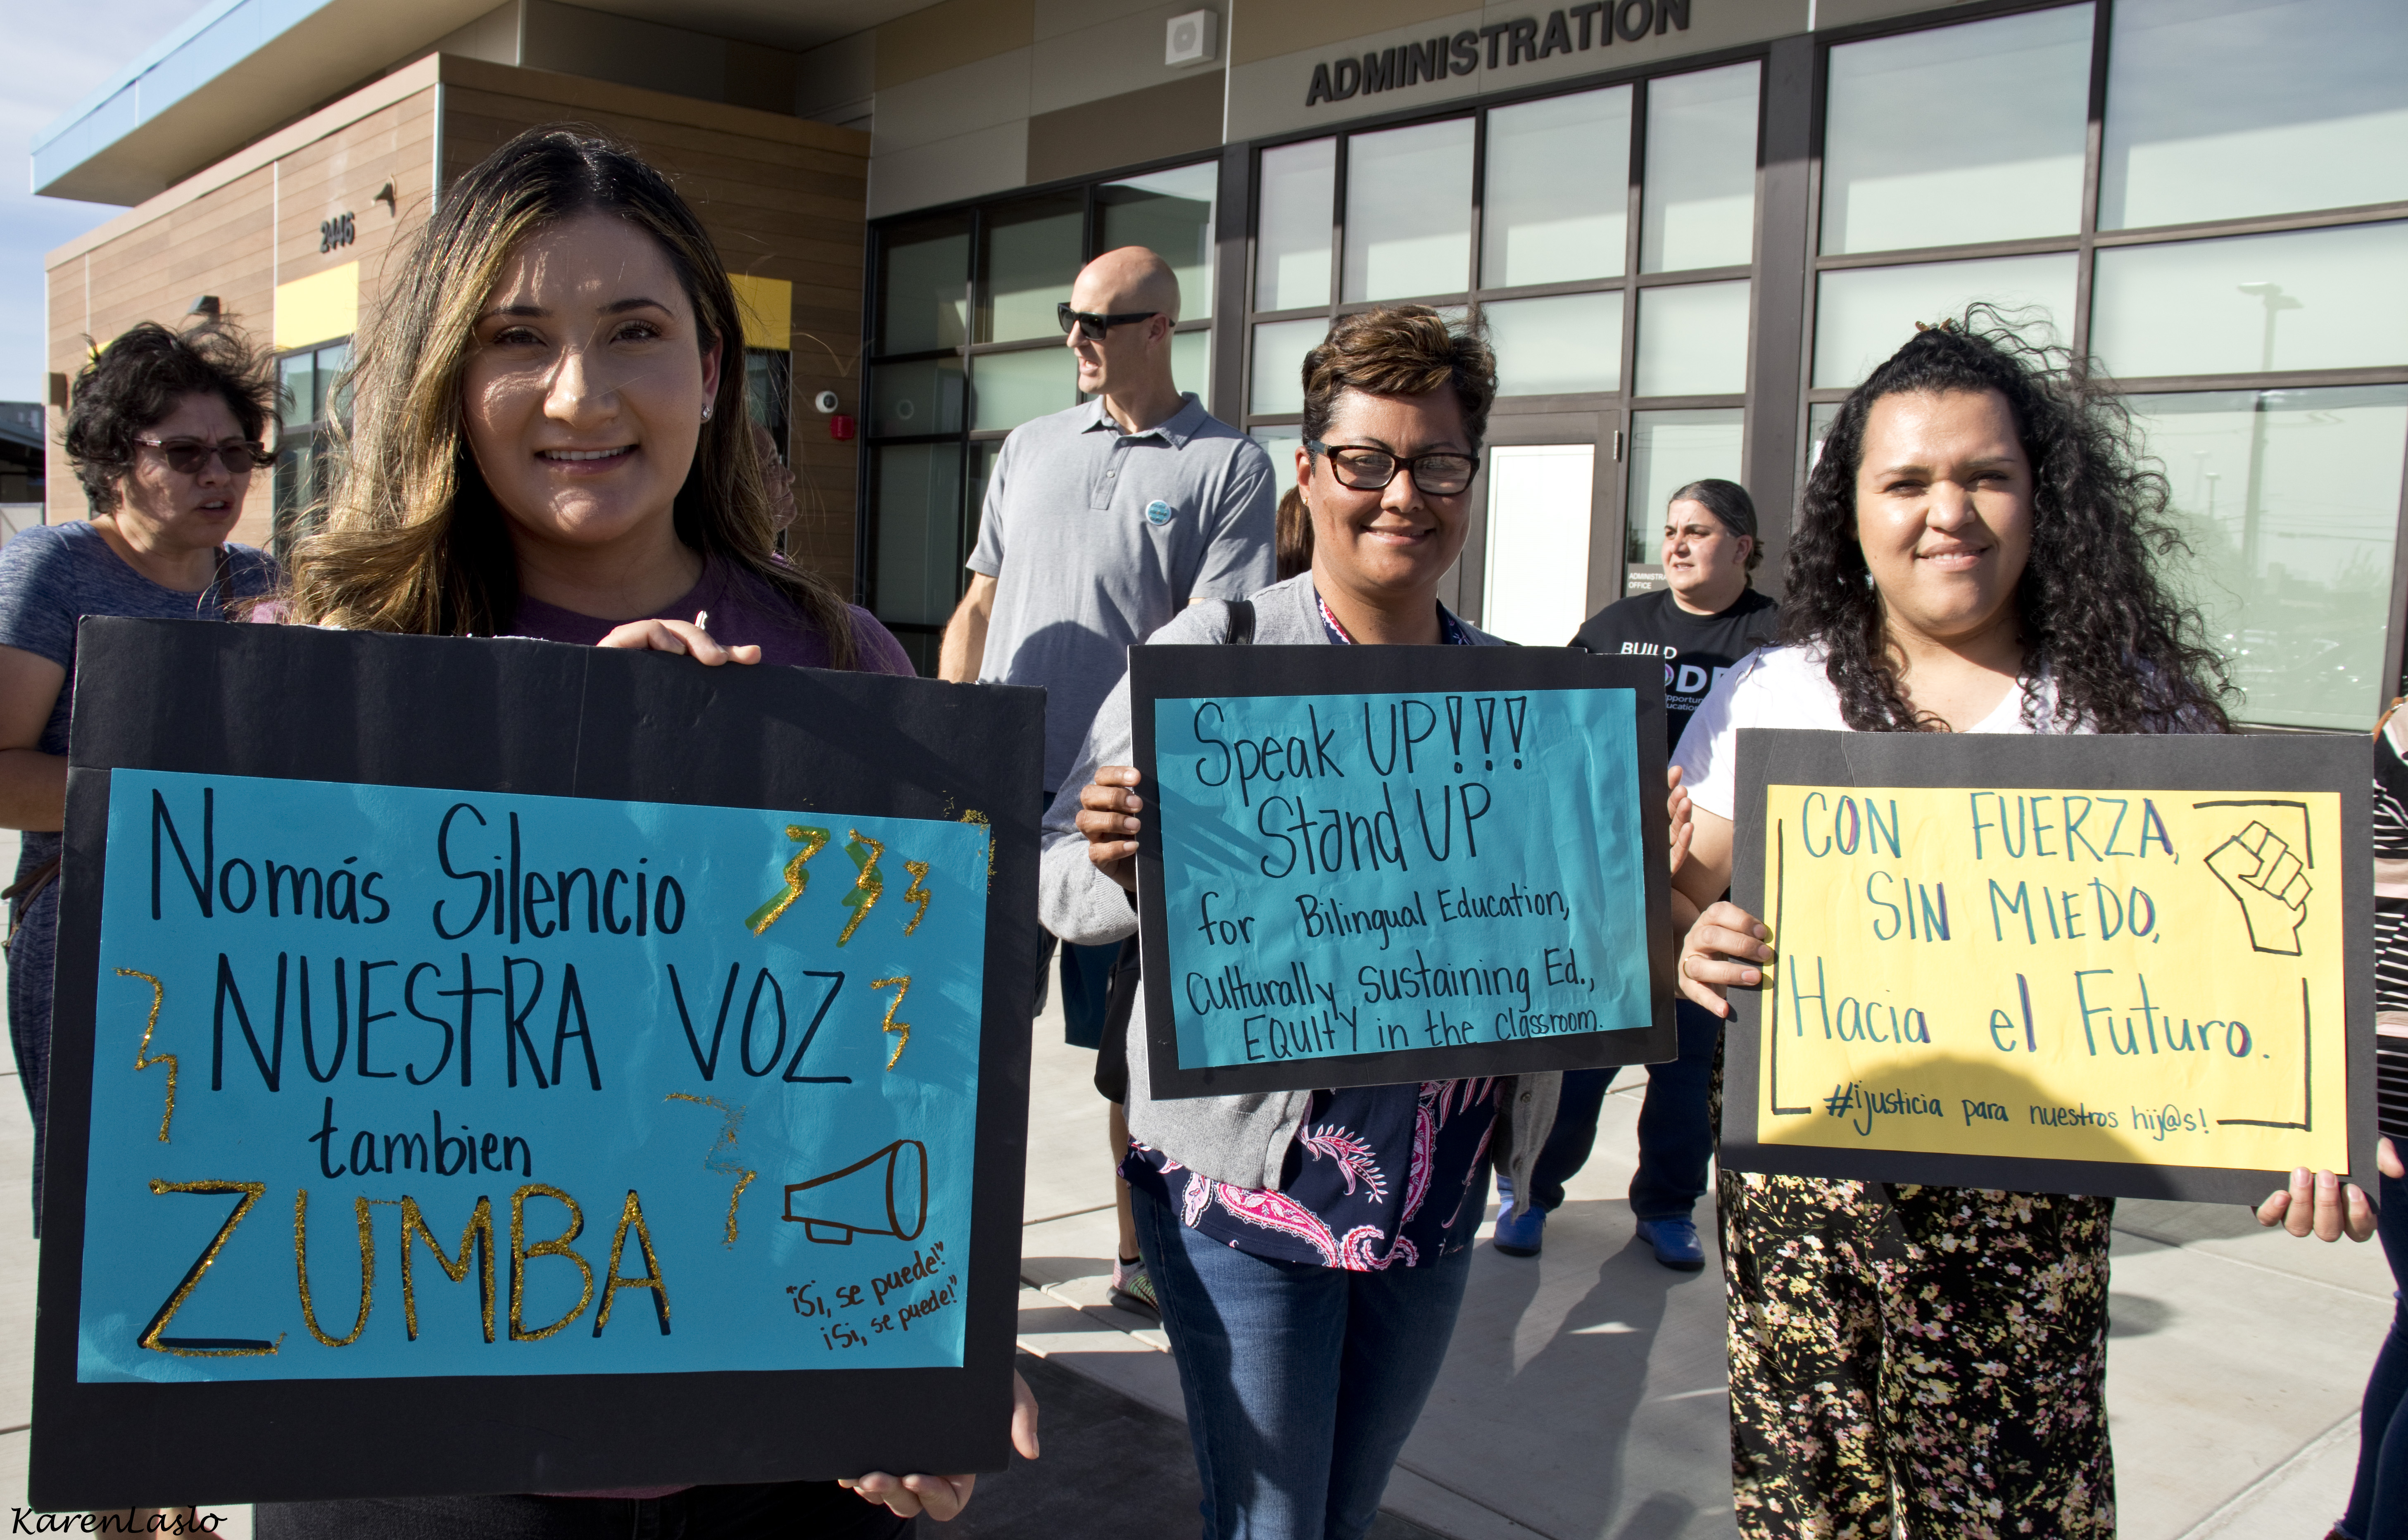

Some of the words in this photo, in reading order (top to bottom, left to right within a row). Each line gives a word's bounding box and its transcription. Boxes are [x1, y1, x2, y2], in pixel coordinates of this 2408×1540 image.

[1305, 0, 1690, 106] ADMINISTRATION
[320, 211, 355, 254] 2446
[1621, 642, 1677, 659] BUILD
[1193, 701, 1344, 806] Speak
[1364, 696, 1526, 777] UP!!!
[1257, 782, 1408, 878] Stand
[1416, 783, 1491, 861] UP
[1802, 792, 1901, 858] CON
[1970, 791, 2180, 865] FUERZA,
[151, 787, 391, 923] Nomás
[433, 802, 685, 944] Silencio
[1198, 891, 1255, 945] for
[1295, 891, 1427, 950] Bilingual
[1437, 882, 1569, 922] Education,
[1866, 871, 1951, 942] SIN
[1988, 877, 2160, 945] MIEDO,
[1186, 961, 1339, 1020] Culturally
[1544, 948, 1595, 992] Ed.,
[1790, 955, 1931, 1043] Hacia
[1990, 973, 2037, 1053] el
[2074, 969, 2270, 1058] Futuro.
[667, 962, 851, 1084] VOZ
[1377, 1018, 1409, 1049] in
[1424, 1009, 1477, 1046] the
[309, 1097, 532, 1179] tambien
[1961, 1099, 2009, 1126] para
[2030, 1103, 2118, 1128] nuestros
[2132, 1104, 2209, 1141] hij@s!
[137, 1177, 671, 1357] ZUMBA
[836, 1285, 865, 1308] se
[871, 1241, 945, 1306] puede!"
[871, 1314, 894, 1333] se
[898, 1274, 958, 1331] puede!"
